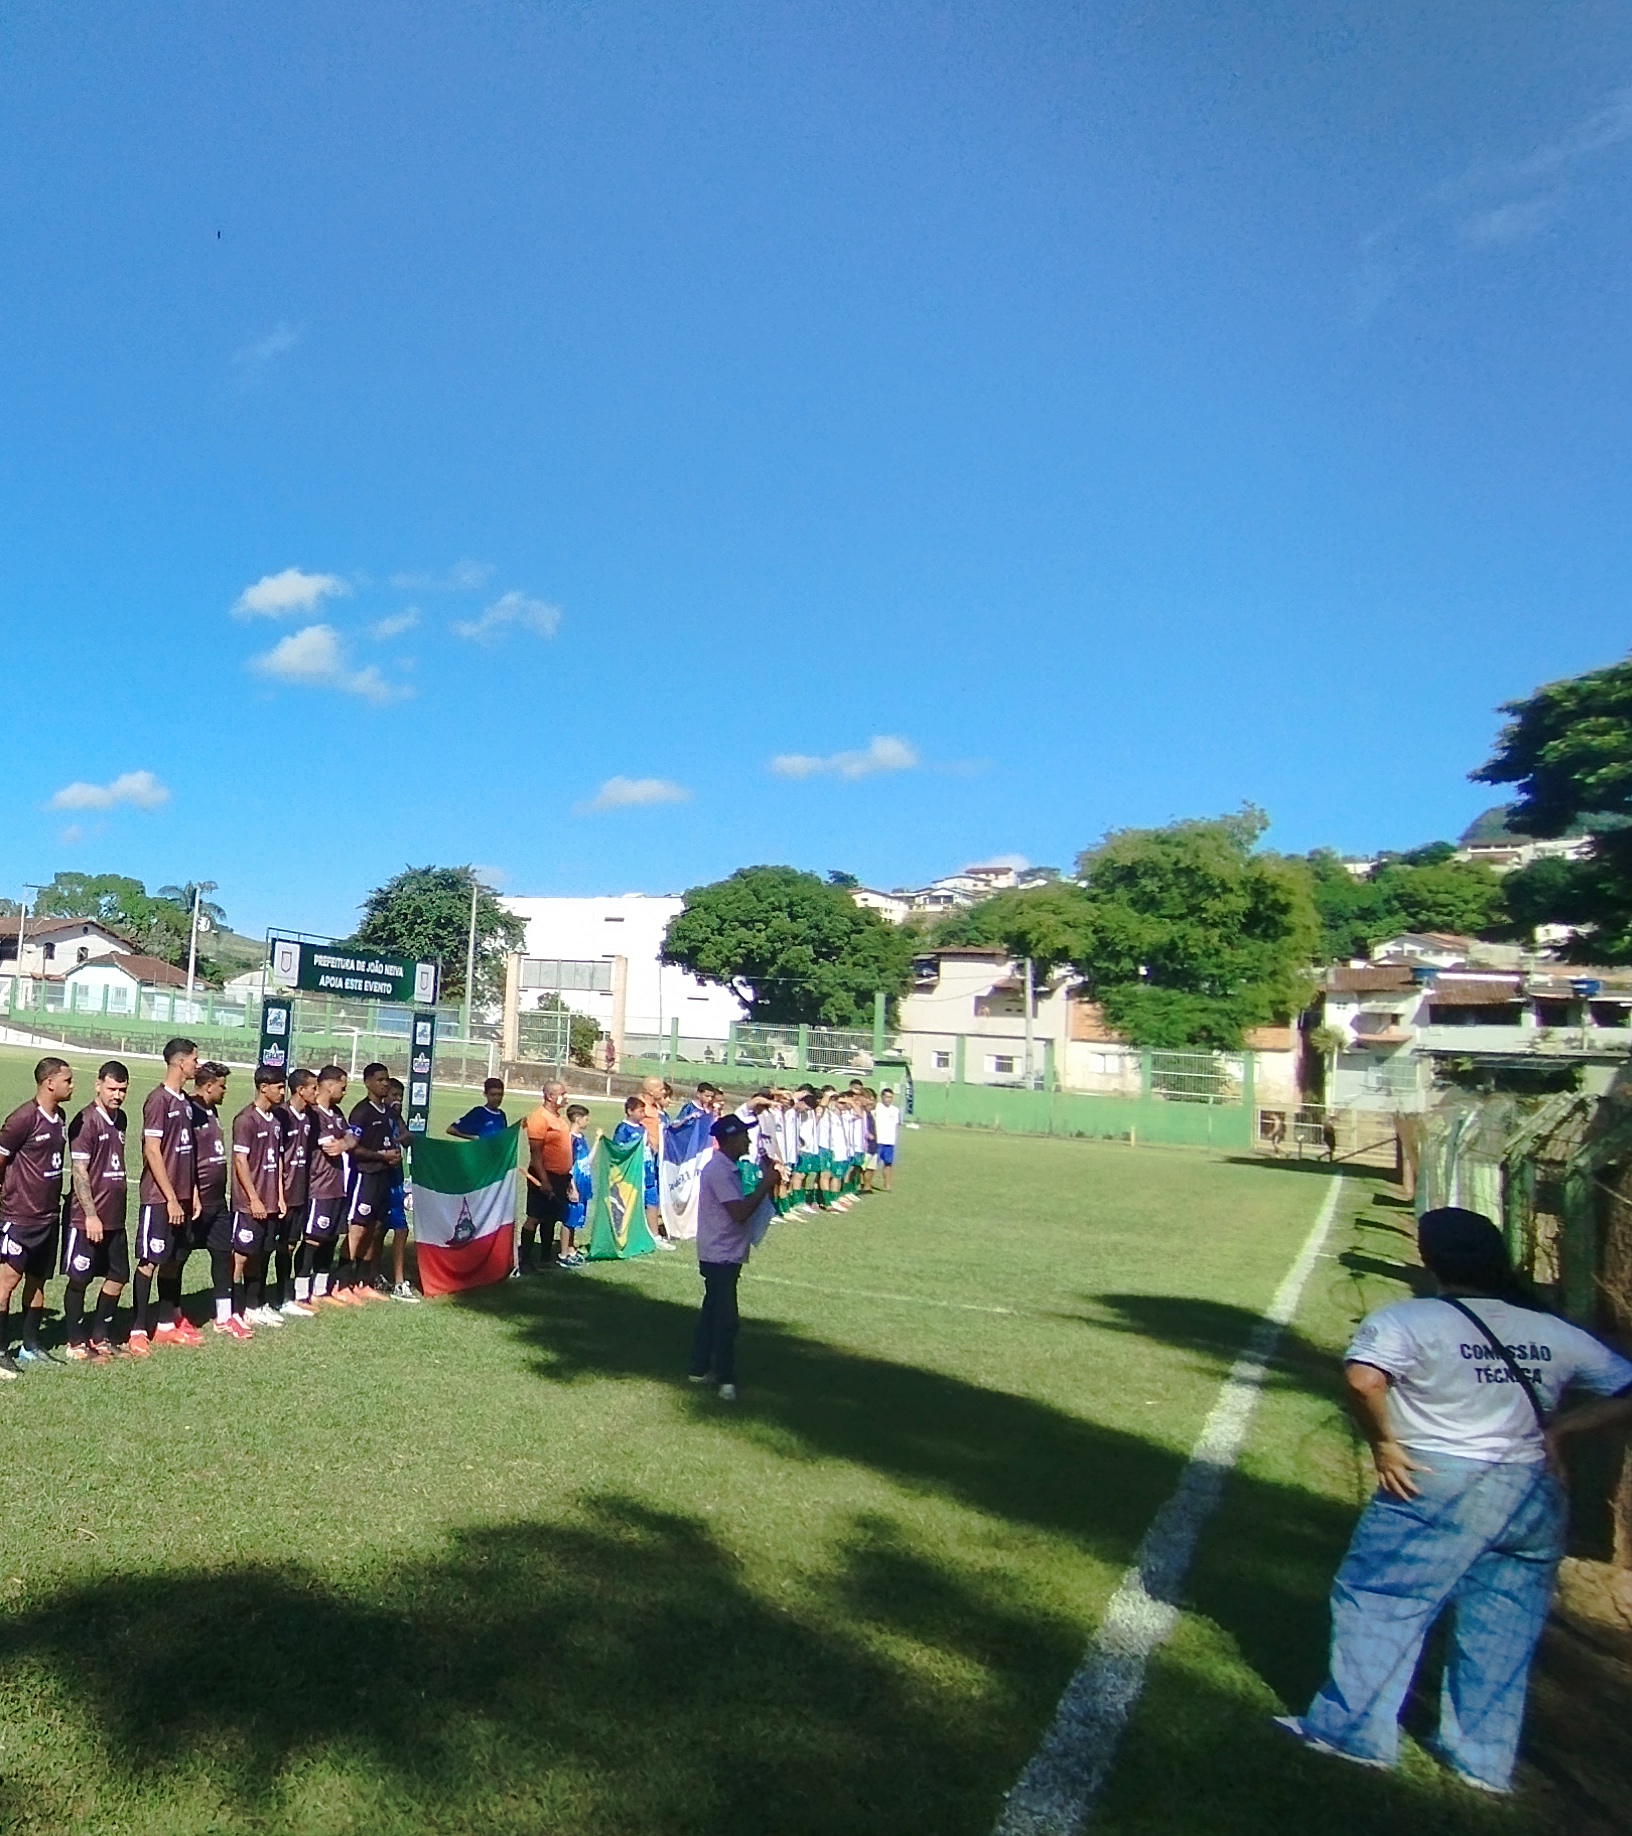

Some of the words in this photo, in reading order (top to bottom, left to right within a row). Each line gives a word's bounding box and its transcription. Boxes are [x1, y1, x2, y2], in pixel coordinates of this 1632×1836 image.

[313, 953, 355, 971] PREFEITURA
[356, 960, 366, 972] DE
[366, 959, 384, 975] JOÃO
[384, 964, 404, 978] NEIVA
[319, 974, 343, 989] APOIA
[344, 977, 363, 991] ESTE
[364, 980, 393, 995] EVENTO
[1474, 1364, 1542, 1384] TÉCNCA
